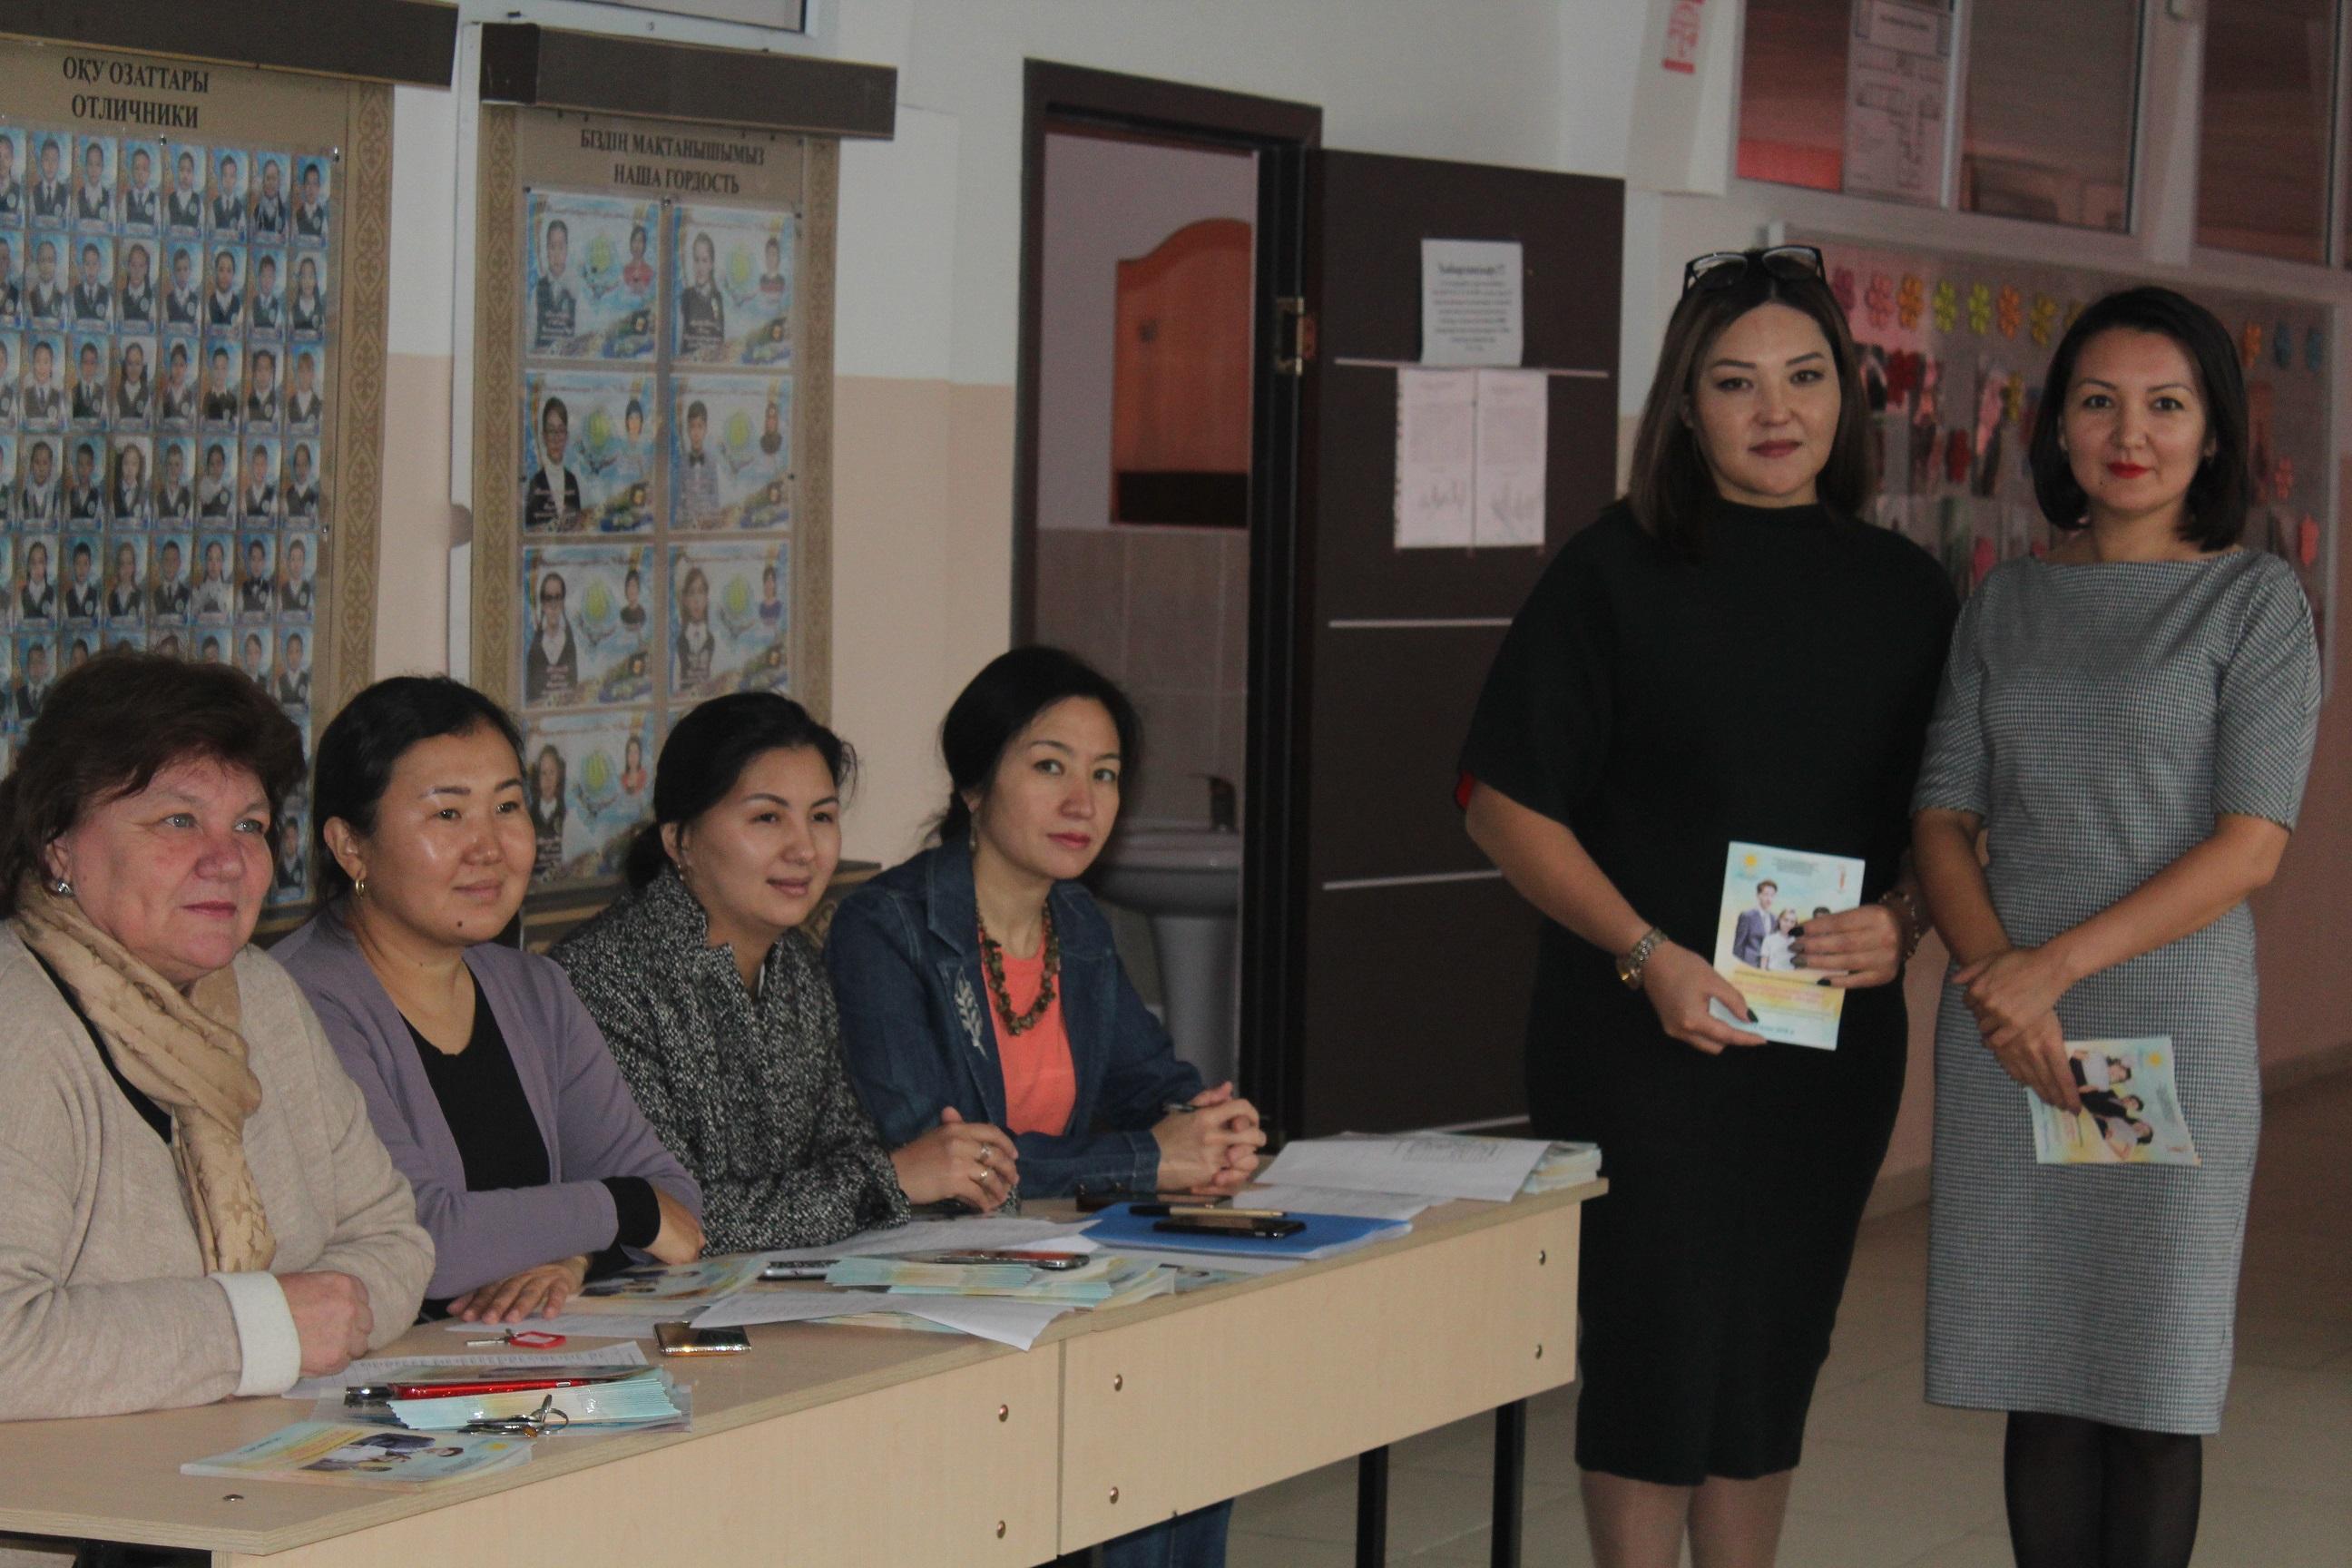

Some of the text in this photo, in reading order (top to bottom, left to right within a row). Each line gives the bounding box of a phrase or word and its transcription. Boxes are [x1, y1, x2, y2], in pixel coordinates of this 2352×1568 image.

[63, 56, 209, 93] ОҚУ ОЗАТТАРЫ
[72, 93, 198, 128] ОТЛИЧНИКИ
[613, 164, 740, 194] НАША ГОРДОСТЬ
